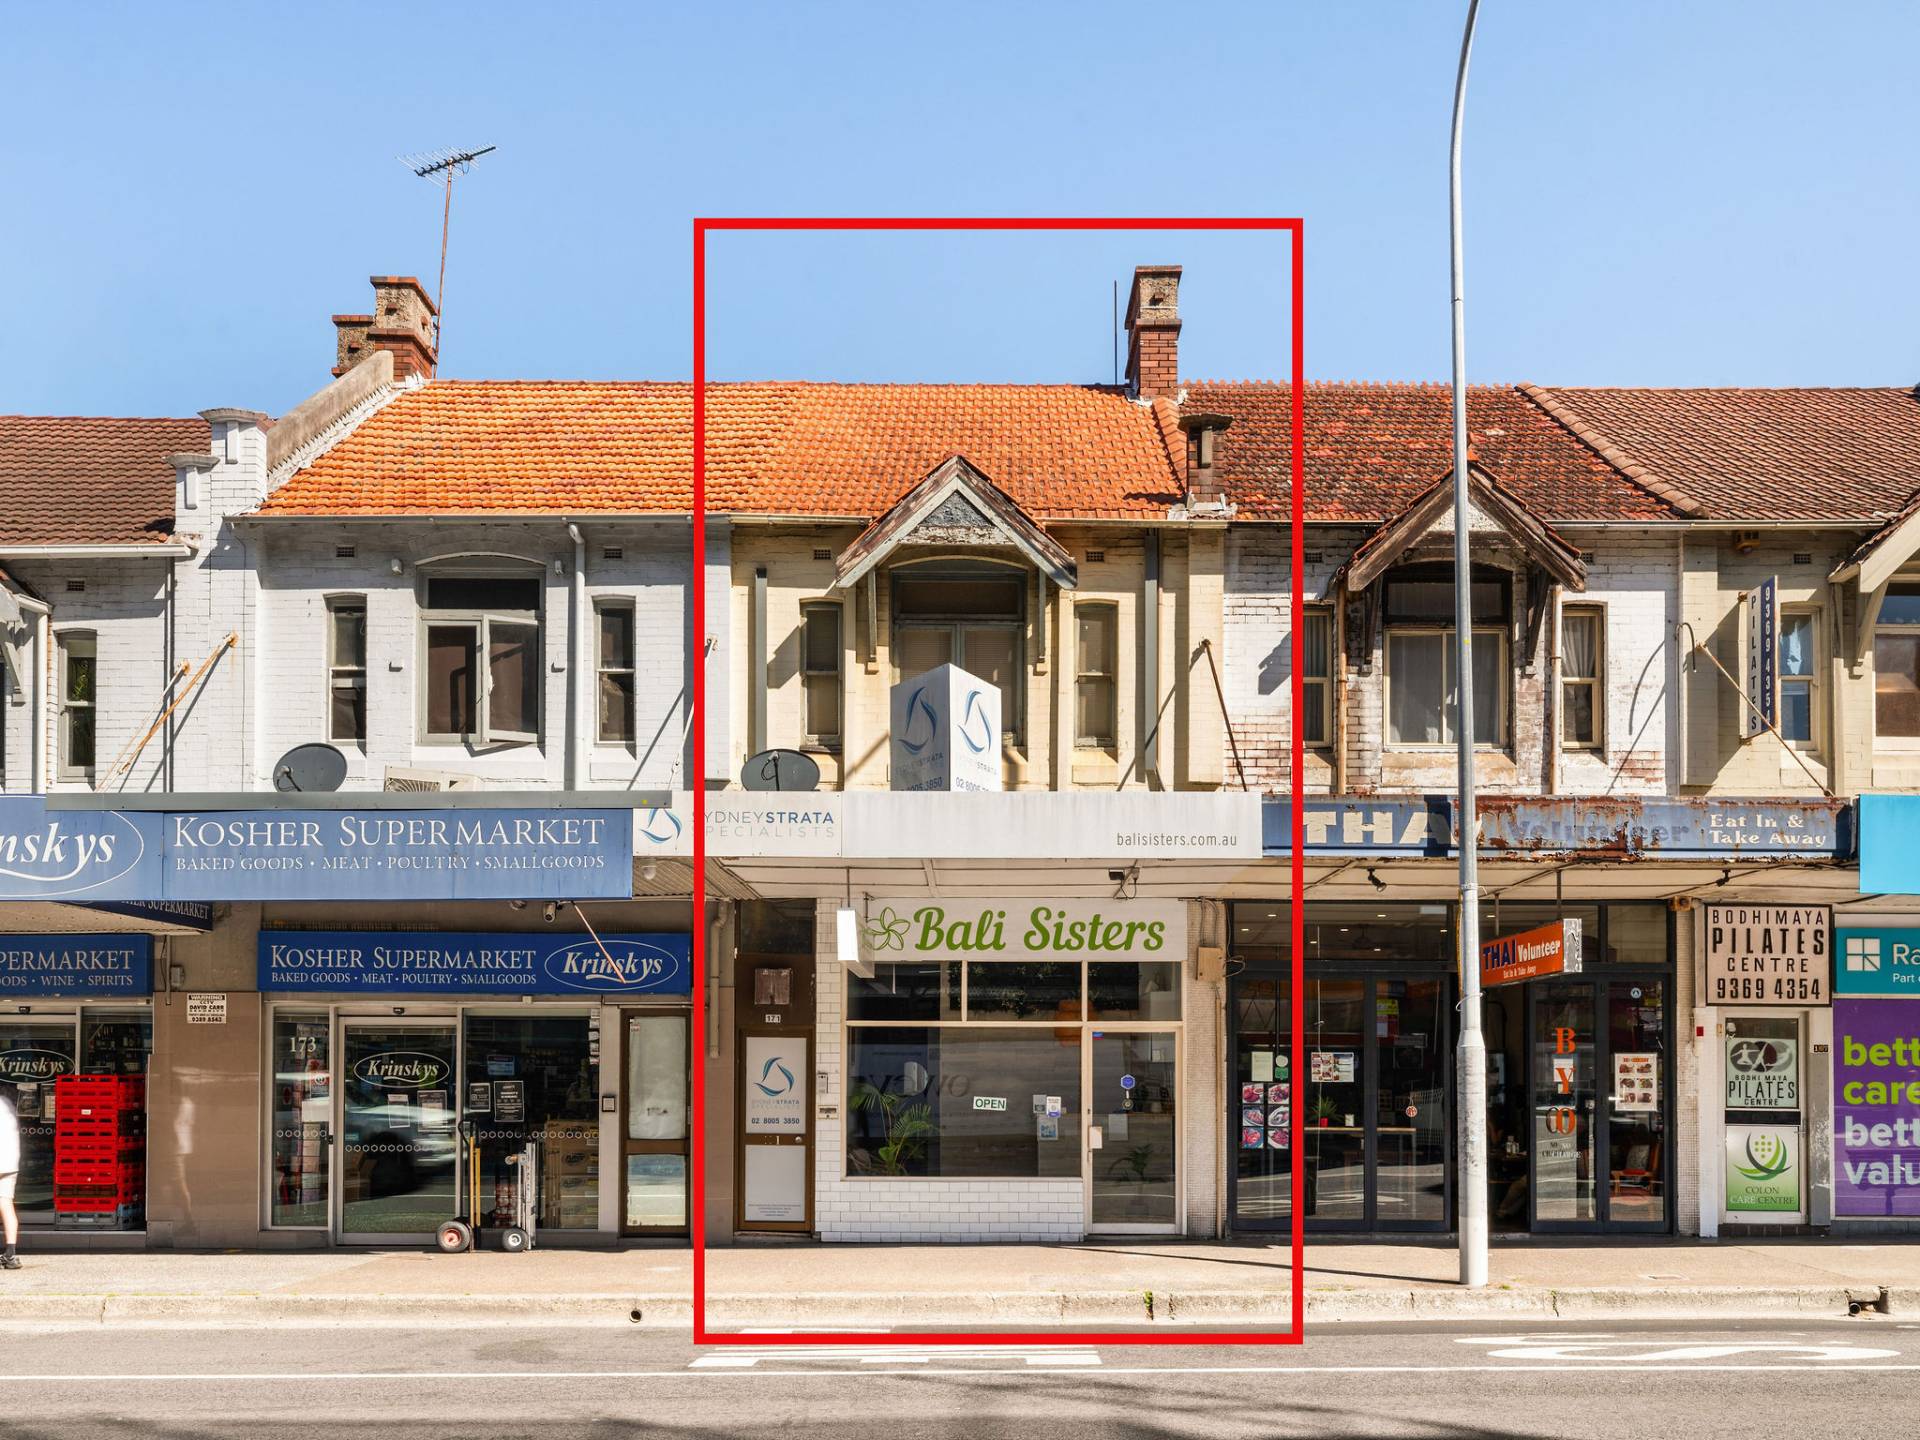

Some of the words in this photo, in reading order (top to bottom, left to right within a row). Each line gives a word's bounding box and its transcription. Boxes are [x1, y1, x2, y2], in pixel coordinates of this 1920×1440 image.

[692, 811, 834, 824] YDNEYSTRATA
[1710, 813, 1747, 828] Eat
[1756, 813, 1777, 828] In
[1787, 814, 1804, 828] &
[174, 816, 324, 848] KOSHER
[340, 815, 605, 847] SUPERMARKET
[692, 826, 834, 838] PECIALISTS
[1303, 811, 1482, 845] THA
[1116, 832, 1237, 846] balisisters.com.au
[1709, 830, 1760, 844] Take
[1769, 831, 1827, 848] Away
[176, 857, 235, 871] BAKED
[240, 857, 304, 871] GOODS
[322, 856, 372, 870] MEAT
[387, 856, 470, 870] POULTRY
[484, 855, 605, 869] SMALLGOODS
[1712, 909, 1824, 925] BODHIMAYA
[913, 906, 1006, 951] Bali
[1023, 906, 1165, 951] Sisters
[1712, 927, 1824, 955] PILATES
[271, 945, 364, 969] KOSHER
[373, 946, 537, 969] SUPERMARKET
[1483, 939, 1517, 972] THAI
[1517, 940, 1561, 962] Volunteer
[1727, 957, 1808, 973] CENTRE
[0, 975, 27, 987] ODS
[41, 975, 75, 986] WINE
[88, 975, 133, 986] SPIRITS
[271, 972, 308, 983] BAKED
[311, 972, 350, 984] GOODS
[362, 973, 393, 984] MEAT
[402, 973, 452, 984] POULTRY
[461, 974, 537, 985] SMALLGOODS
[1892, 973, 1915, 983] Part
[1717, 978, 1764, 999] 9369
[1774, 978, 1820, 999] 4354
[290, 1036, 317, 1053] 173
[1843, 1035, 1920, 1067] bett
[367, 1059, 440, 1083] Krinskys
[1729, 1081, 1795, 1099] PILATES
[1843, 1080, 1920, 1105] care
[975, 1098, 1006, 1109] OPEN
[1744, 1098, 1779, 1106] CENTRE
[1844, 1115, 1920, 1148] bett
[1843, 1154, 1920, 1185] valu
[1745, 1186, 1780, 1194] COLON
